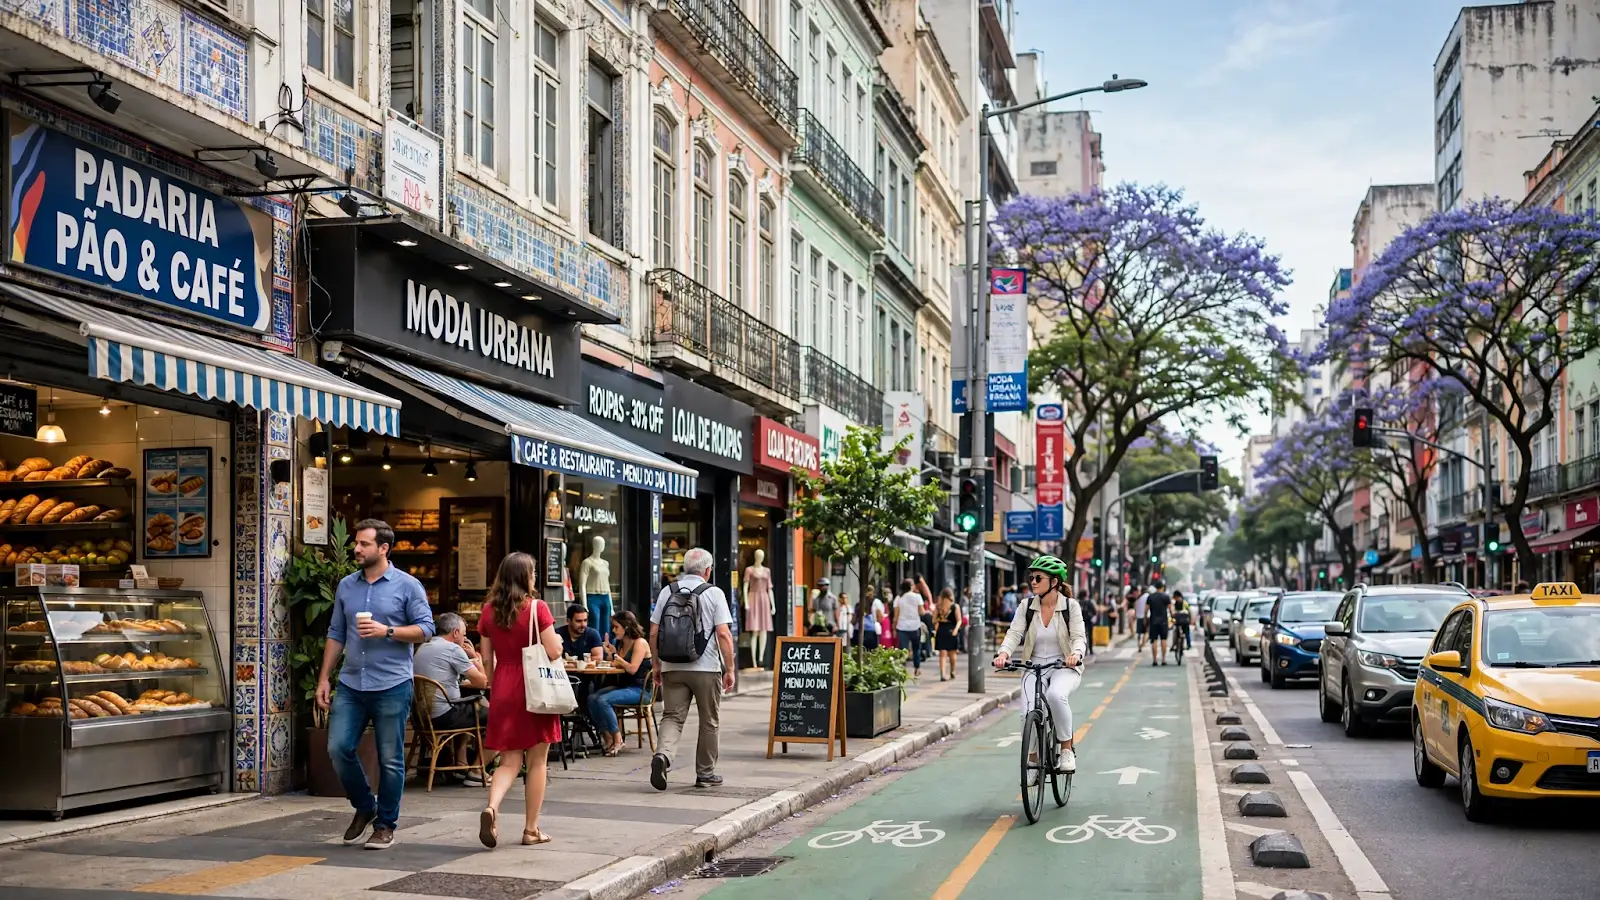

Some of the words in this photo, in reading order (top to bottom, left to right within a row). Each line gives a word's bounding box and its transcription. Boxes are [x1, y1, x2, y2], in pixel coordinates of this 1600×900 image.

[75, 148, 219, 248] PADARIA
[56, 207, 127, 282] PÃO
[137, 239, 160, 293] &
[170, 250, 245, 318] CAFÉ
[406, 279, 474, 351] MODA
[479, 307, 555, 379] URBANA
[589, 384, 625, 423] ROUPAS
[631, 398, 648, 430] 30%
[672, 406, 696, 448] LOJA
[698, 415, 710, 452] DE
[711, 420, 742, 461] ROUPAS
[767, 428, 784, 460] LOJA
[785, 435, 794, 464] DE
[524, 440, 548, 465] CAFÉ
[550, 448, 557, 467] &
[559, 448, 615, 479] RESTAURANTE
[622, 463, 643, 484] MENU
[643, 469, 654, 487] DO
[654, 471, 667, 493] DIA
[574, 505, 592, 522] MODA
[593, 508, 617, 525] URBANA
[1541, 585, 1574, 596] TAXI
[782, 661, 830, 675] RESTAURANTE
[787, 645, 811, 660] CAFÉ
[813, 649, 821, 660] &
[784, 677, 805, 689] MENU
[805, 679, 815, 689] DO
[816, 678, 828, 689] DIA
